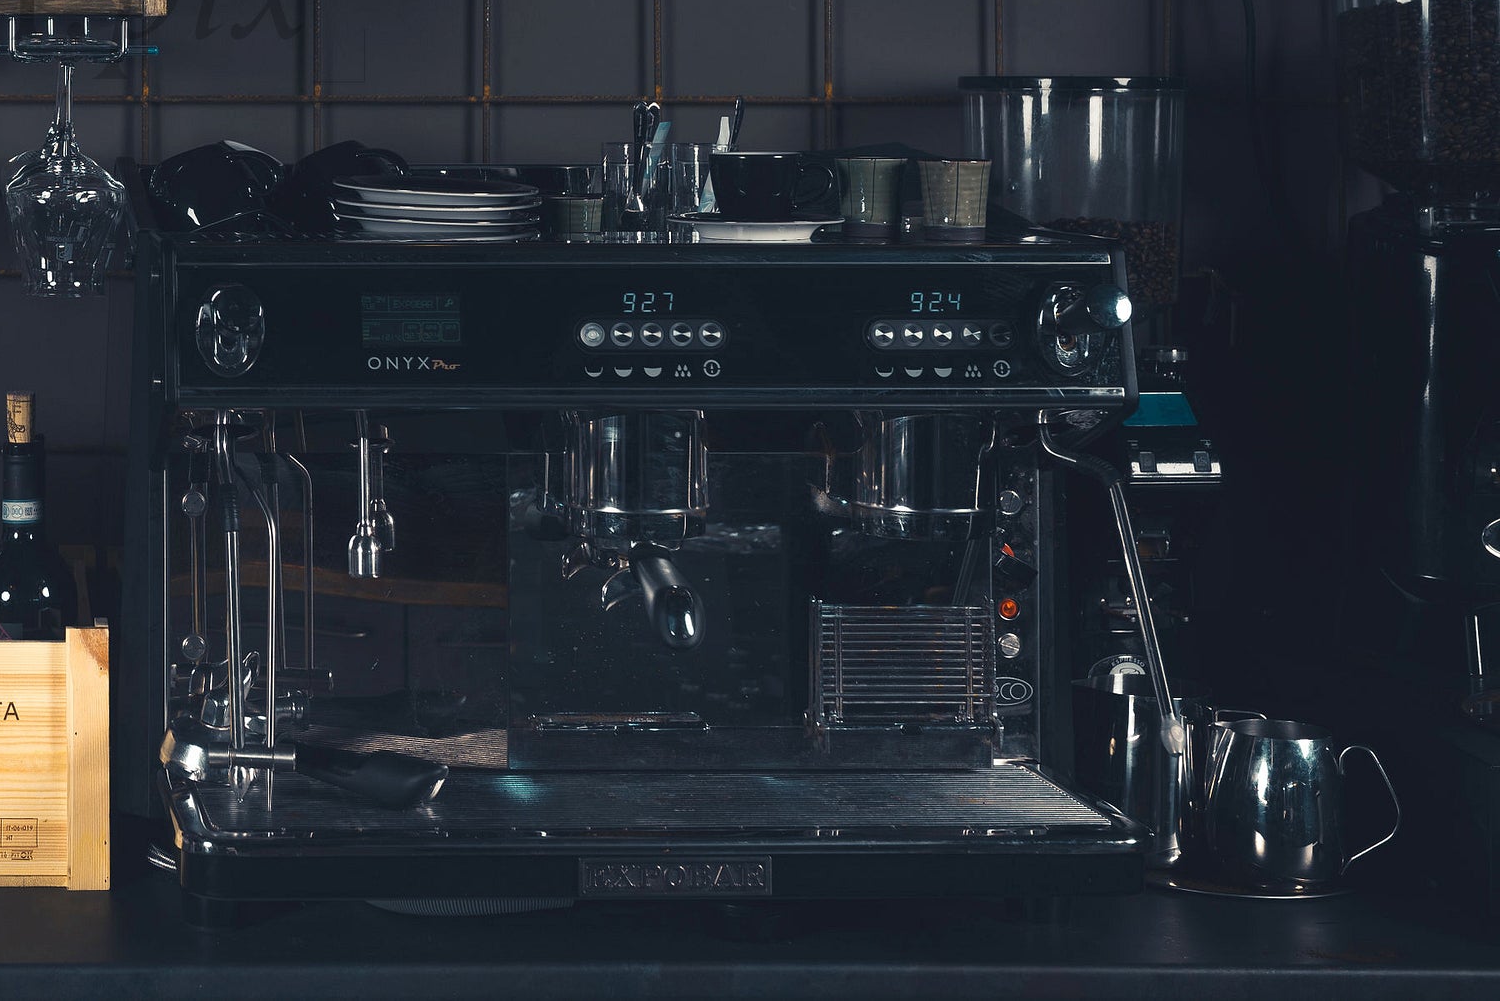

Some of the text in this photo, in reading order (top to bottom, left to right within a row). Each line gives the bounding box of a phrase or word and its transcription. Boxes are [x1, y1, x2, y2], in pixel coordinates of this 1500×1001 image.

[910, 291, 962, 313] 92.4
[367, 356, 461, 371] ONYX Pro
[586, 863, 765, 887] EXPOBAR
